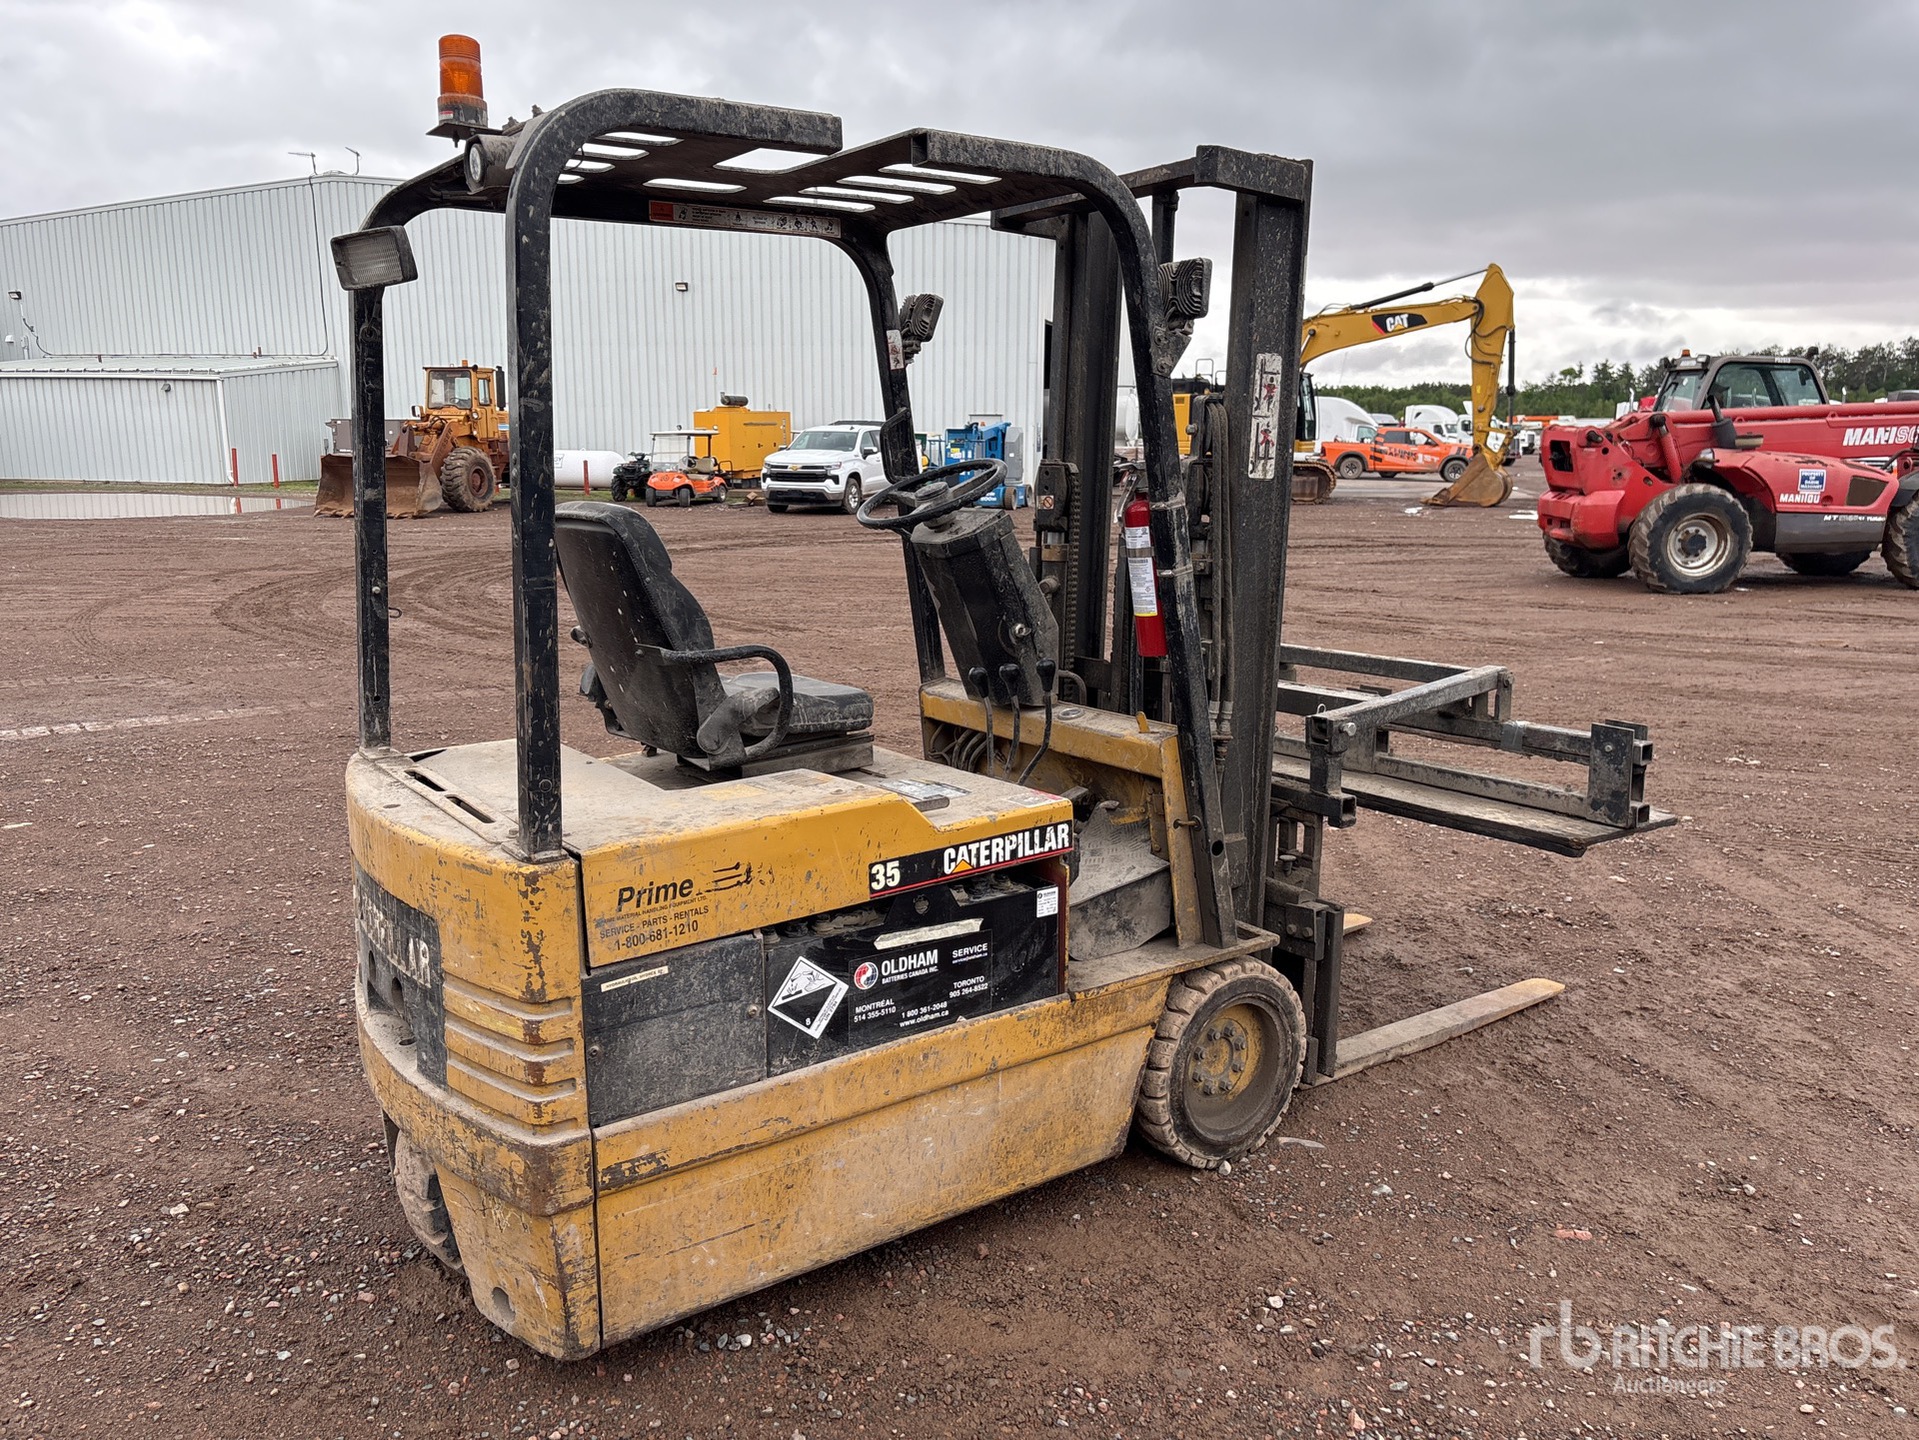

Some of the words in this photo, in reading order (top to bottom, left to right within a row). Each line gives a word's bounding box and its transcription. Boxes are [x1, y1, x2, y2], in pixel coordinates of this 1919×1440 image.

[1386, 313, 1408, 332] CAT
[1779, 493, 1820, 504] MANITOU
[871, 860, 901, 890] 35
[943, 823, 1070, 875] CATERPILLAR
[616, 878, 694, 912] Prime
[600, 923, 635, 939] SERVICE
[642, 915, 668, 929] PARTS
[673, 905, 709, 921] RENTALS
[614, 920, 699, 951] 1-800-681-1210
[952, 943, 988, 958] SERVICE
[881, 949, 938, 976] OLDHAM
[882, 972, 908, 985] BATTERIES
[908, 968, 928, 981] CANADA
[929, 965, 939, 974] INC.
[953, 975, 985, 989] TORONTO
[949, 990, 961, 999] 905
[854, 1014, 866, 1023] 514
[867, 1006, 896, 1019] 355-5110
[906, 1008, 918, 1017] 800
[920, 1001, 948, 1014] 361-2048
[805, 1017, 811, 1026] 8
[900, 1010, 949, 1027] www.oldham.ca
